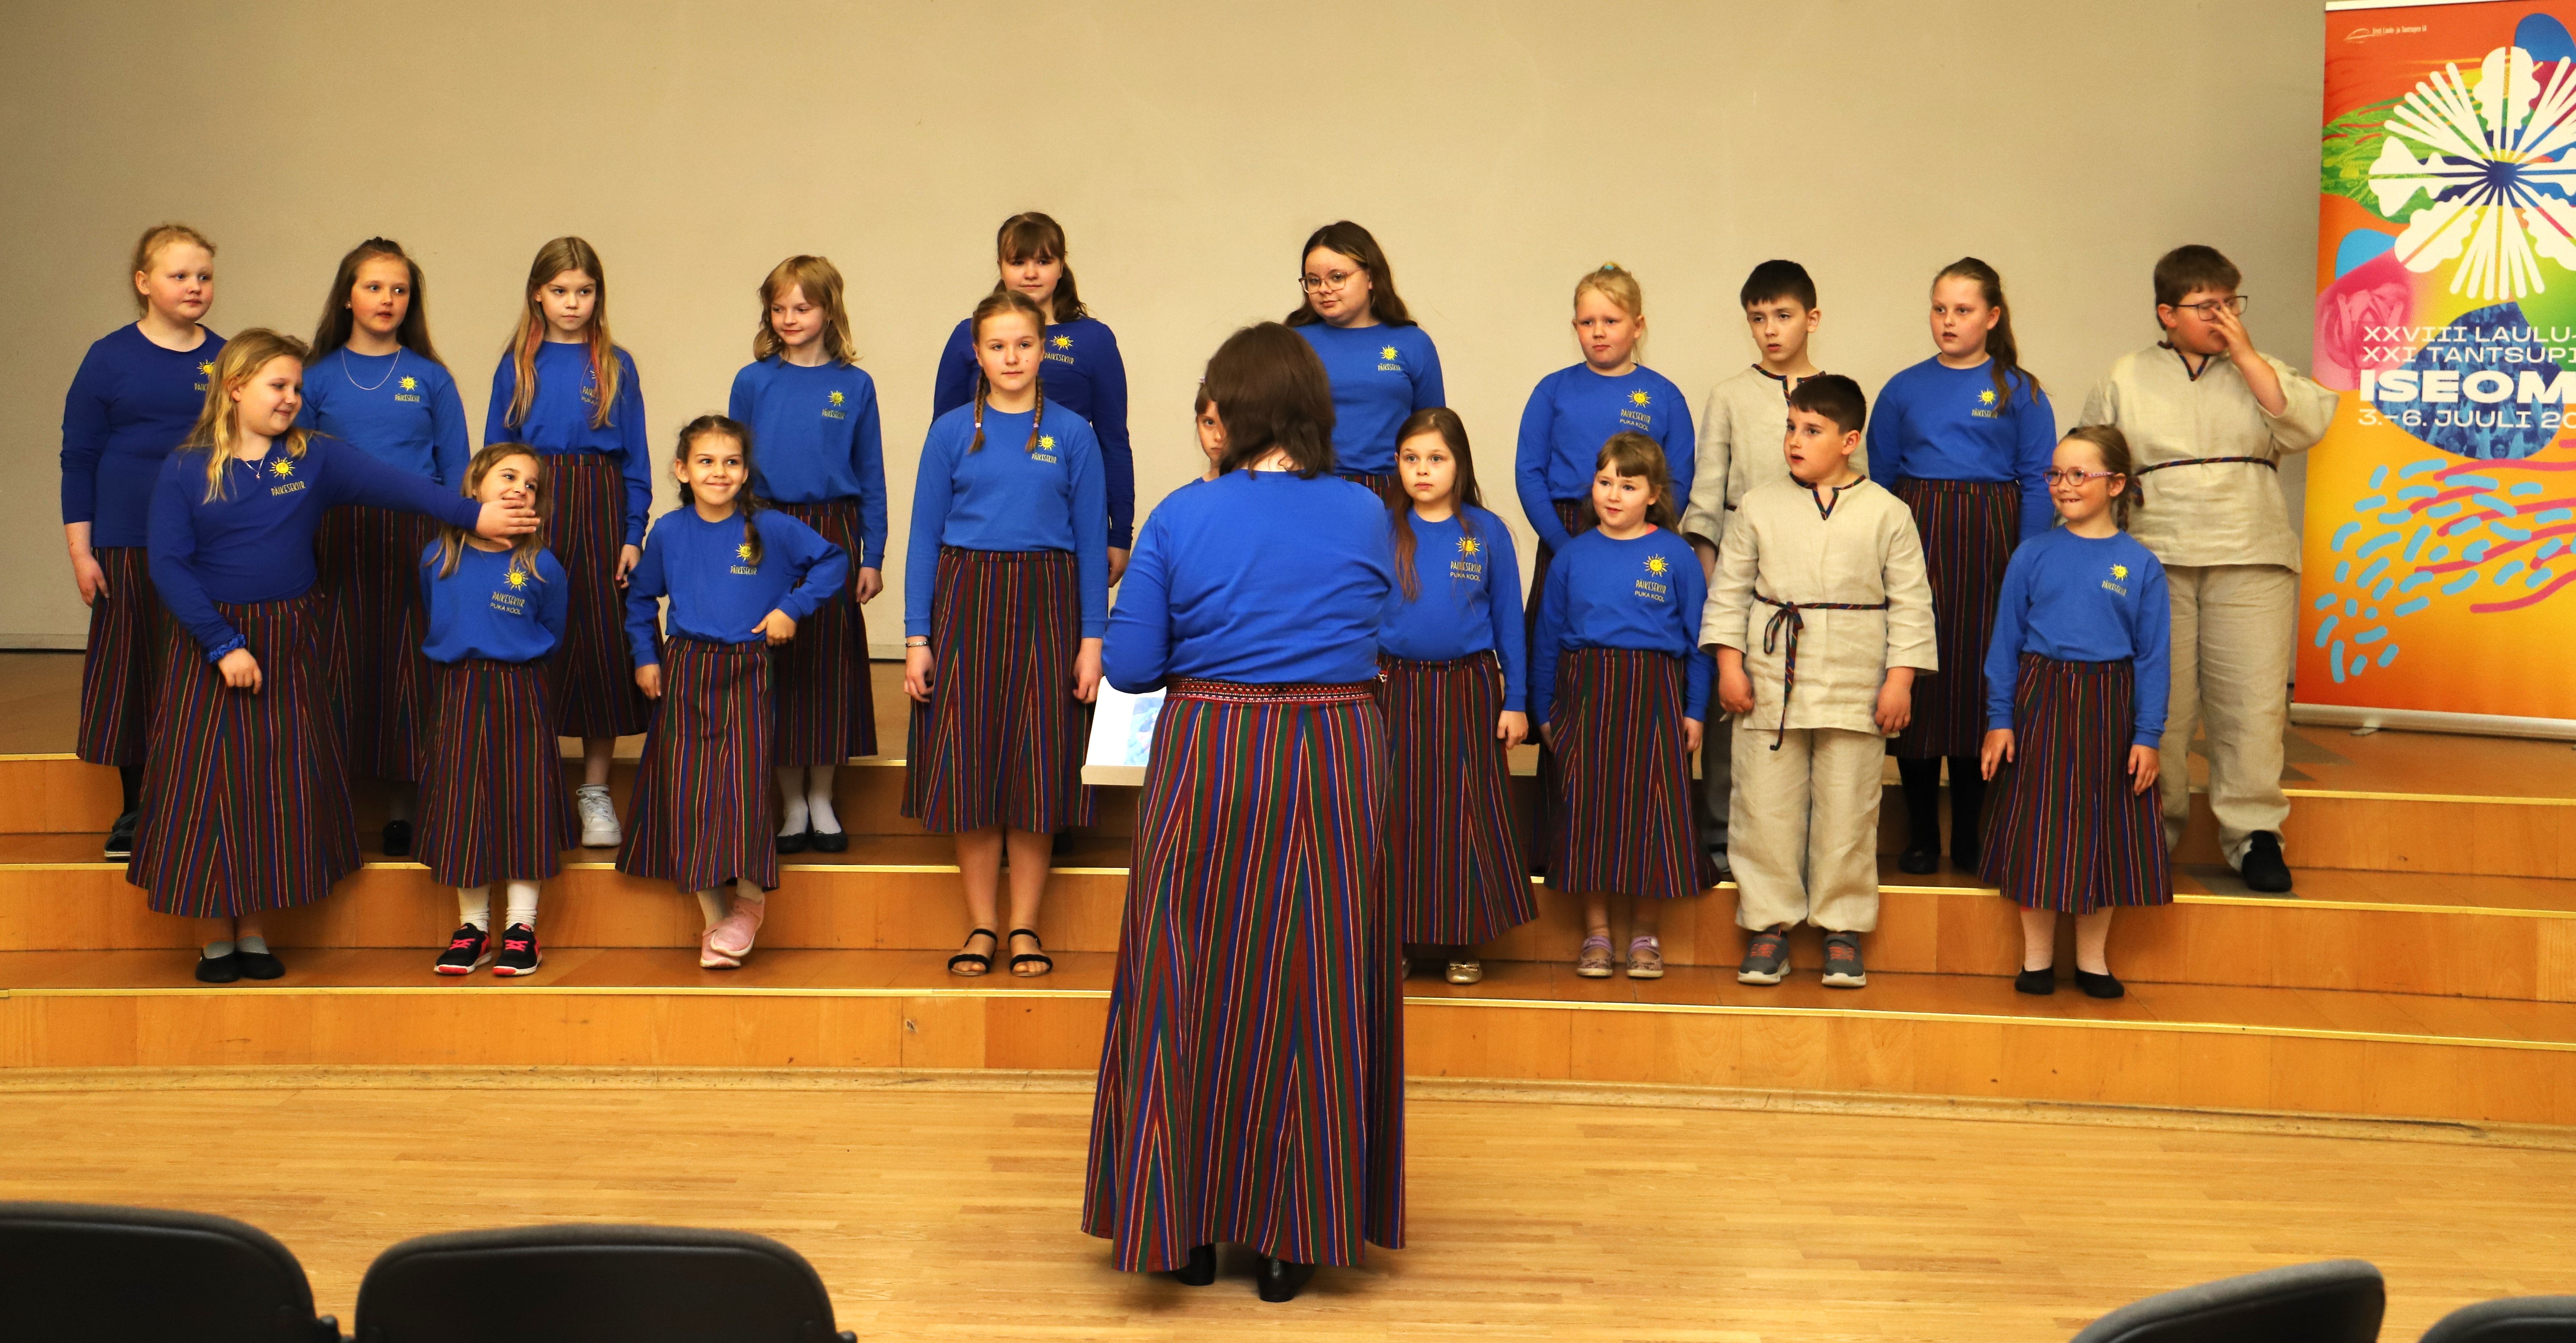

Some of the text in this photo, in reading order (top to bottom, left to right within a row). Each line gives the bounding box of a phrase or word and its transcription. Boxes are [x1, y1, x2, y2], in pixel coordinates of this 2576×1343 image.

[2363, 326, 2467, 342] XXVIII
[1044, 351, 1074, 365] PÄIKESEKIIR
[2362, 346, 2416, 362] XXI
[2360, 369, 2576, 404] ISEOM
[1621, 408, 1651, 424] PÄIKESEKIIR
[2435, 410, 2532, 428] JUULI
[1636, 421, 1649, 431] KOOL
[271, 481, 306, 496] PÄIKESEKIIR
[1636, 579, 1666, 594] PÄIKESEKIIR
[492, 591, 525, 608] PÄIKESEKIIR
[1651, 593, 1665, 602] KOOL
[490, 602, 521, 615] PUKA KOOL
